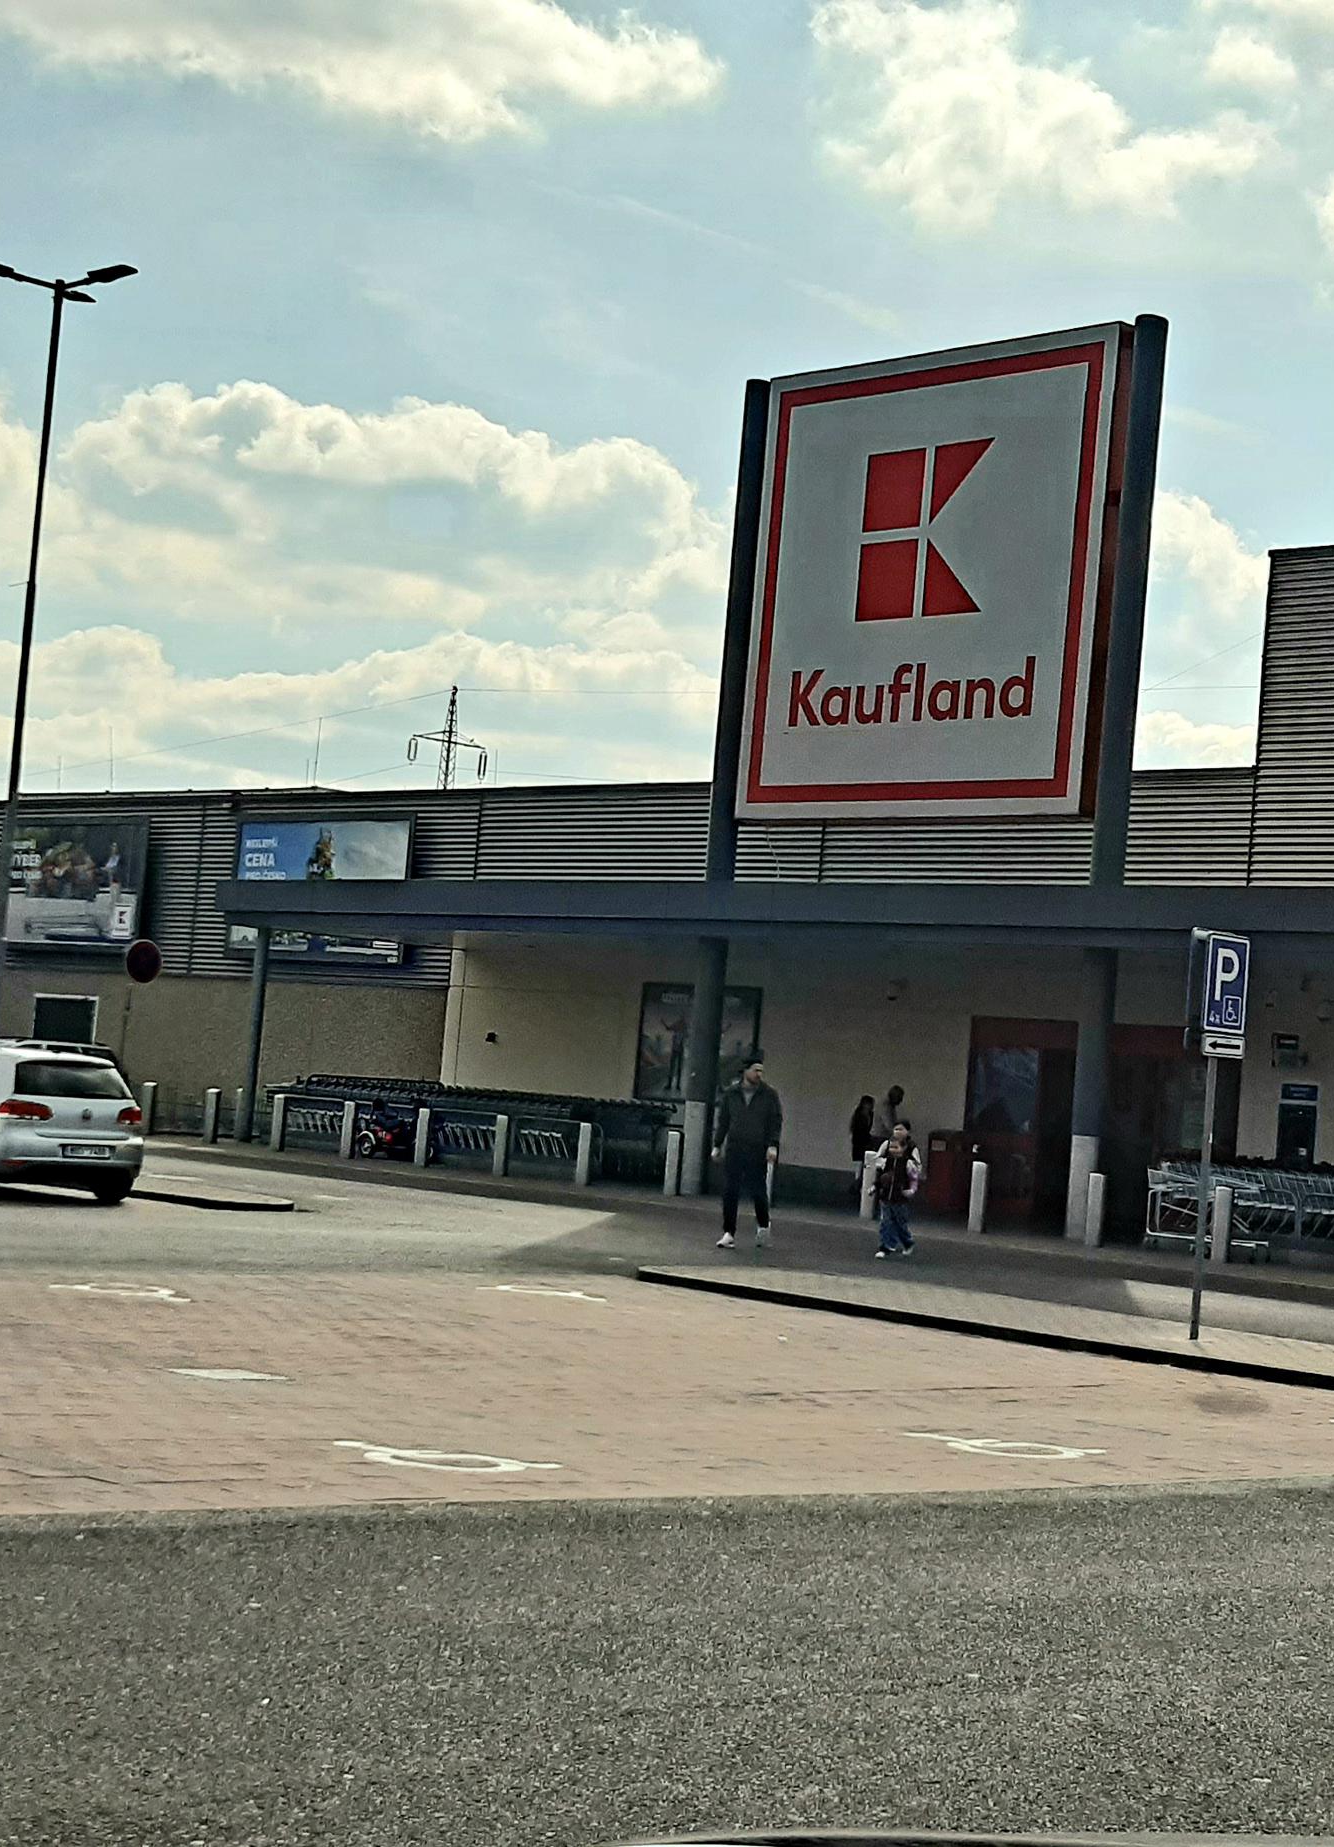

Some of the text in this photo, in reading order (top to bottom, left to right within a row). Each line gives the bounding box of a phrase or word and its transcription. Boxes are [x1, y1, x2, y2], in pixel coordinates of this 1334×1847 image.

[788, 655, 1037, 727] Kaufland
[245, 853, 275, 867] CENA
[1214, 947, 1240, 1001] P
[1209, 1010, 1221, 1024] 4x
